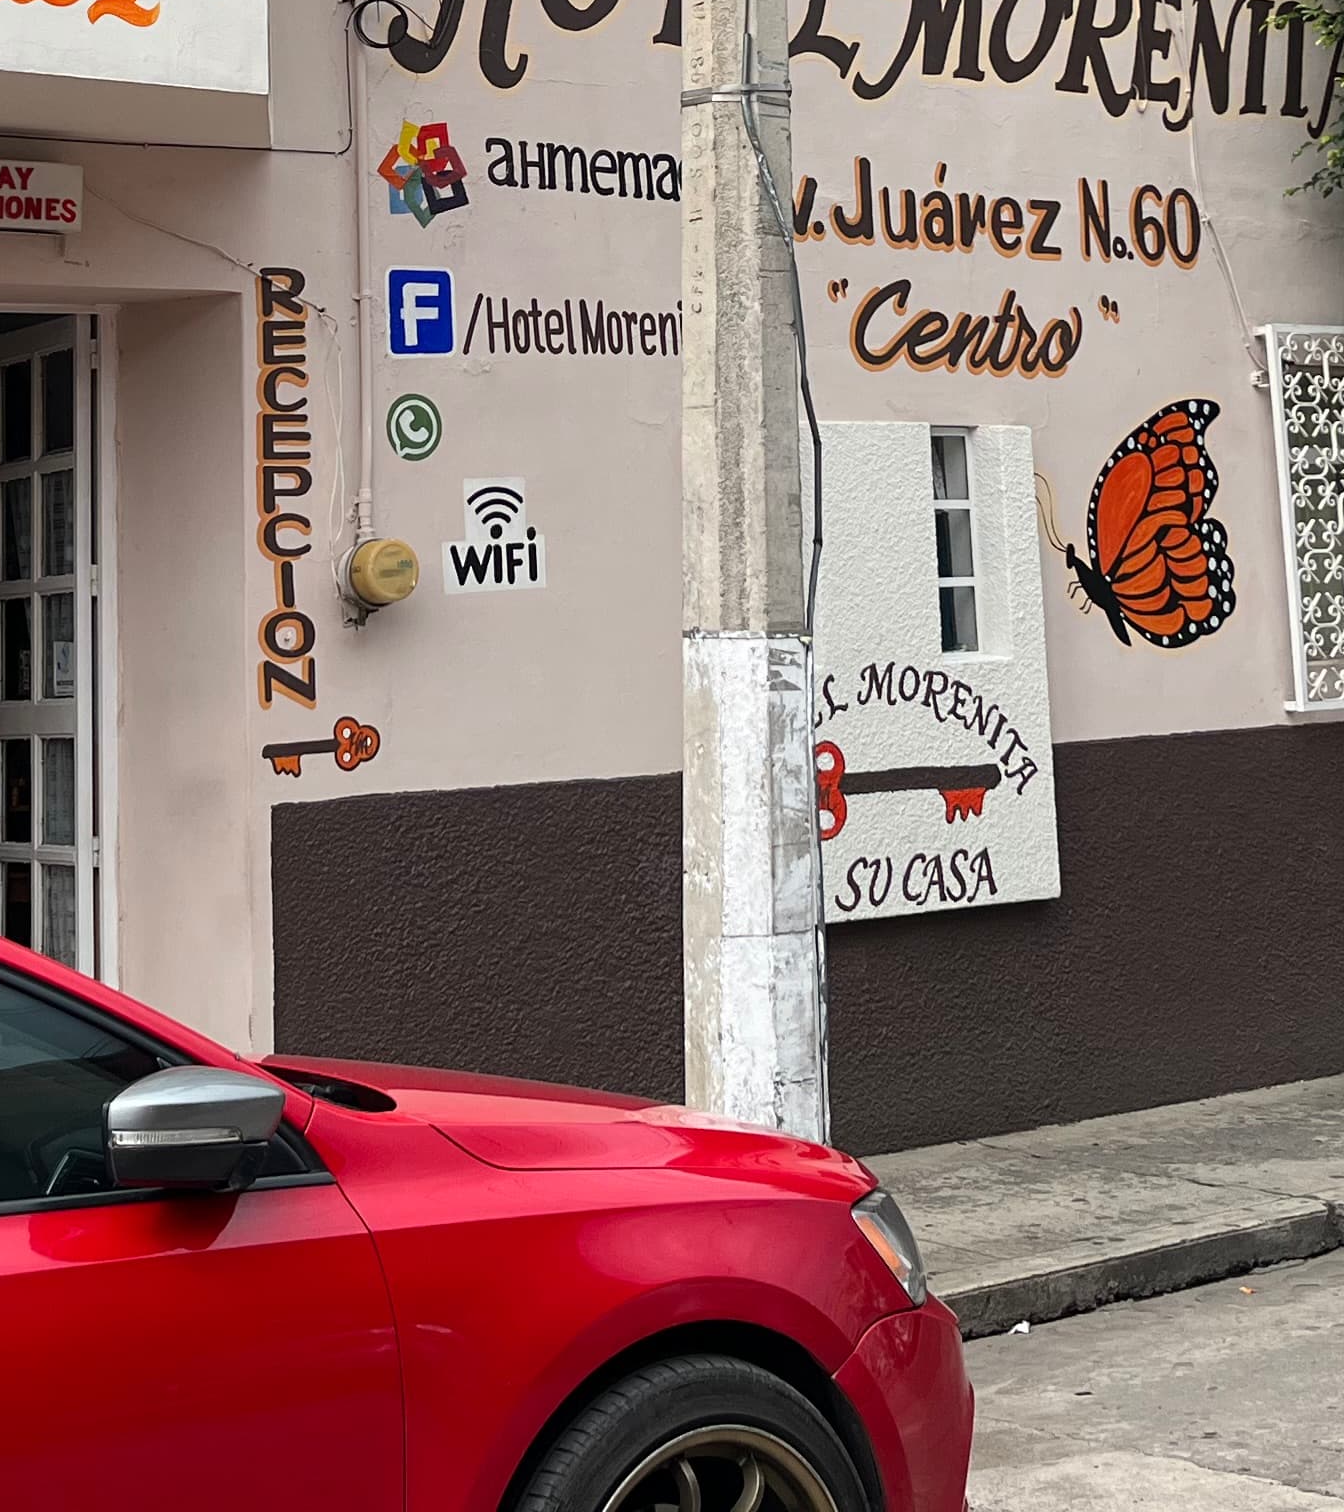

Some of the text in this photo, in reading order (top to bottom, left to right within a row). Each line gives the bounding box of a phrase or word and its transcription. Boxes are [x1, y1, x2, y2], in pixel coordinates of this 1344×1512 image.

[829, 155, 1062, 259] Juárez
[256, 267, 317, 710] RECEPCION
[857, 661, 1038, 795] MORENITA
[835, 847, 998, 912] SU CASA
